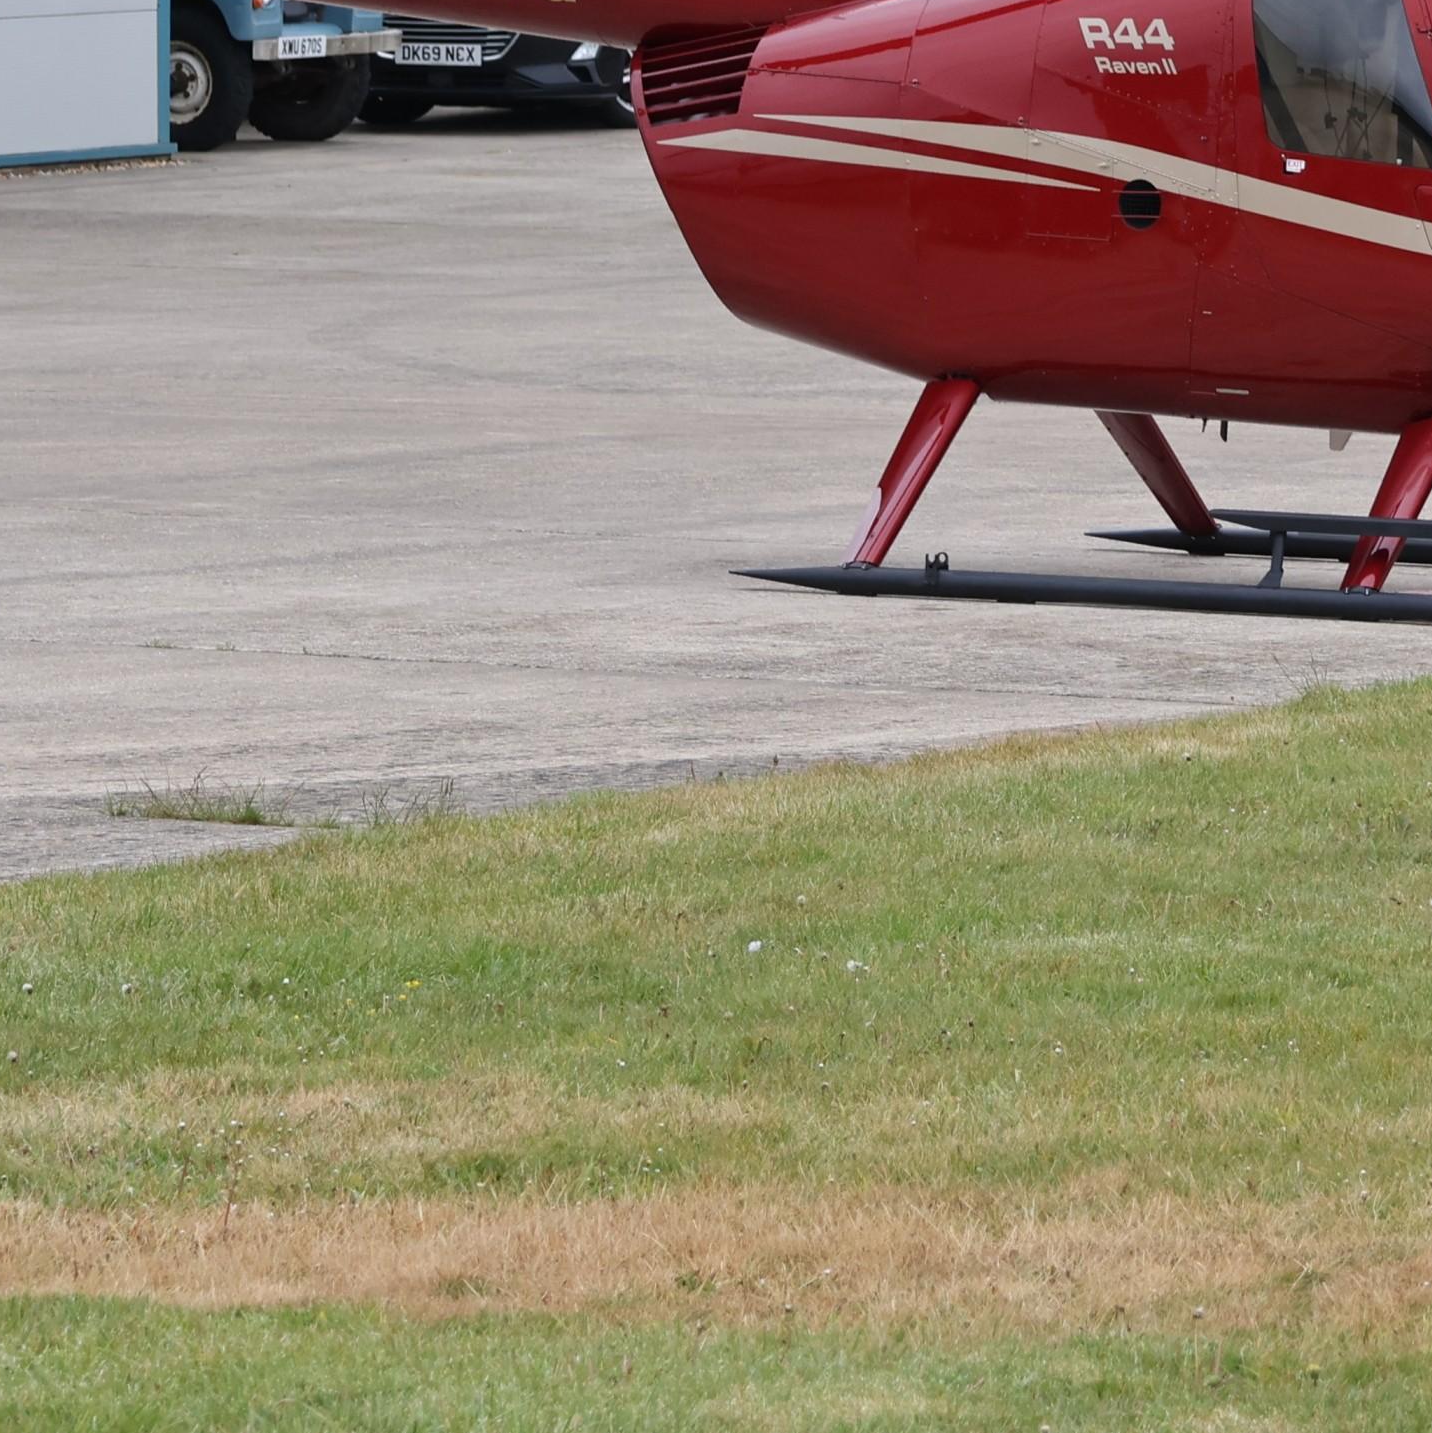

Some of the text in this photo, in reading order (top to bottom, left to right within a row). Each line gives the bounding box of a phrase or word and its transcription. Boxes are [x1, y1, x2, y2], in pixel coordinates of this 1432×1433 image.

[1078, 17, 1175, 51] R44
[402, 45, 441, 61] DK69
[1094, 56, 1178, 75] Raven II
